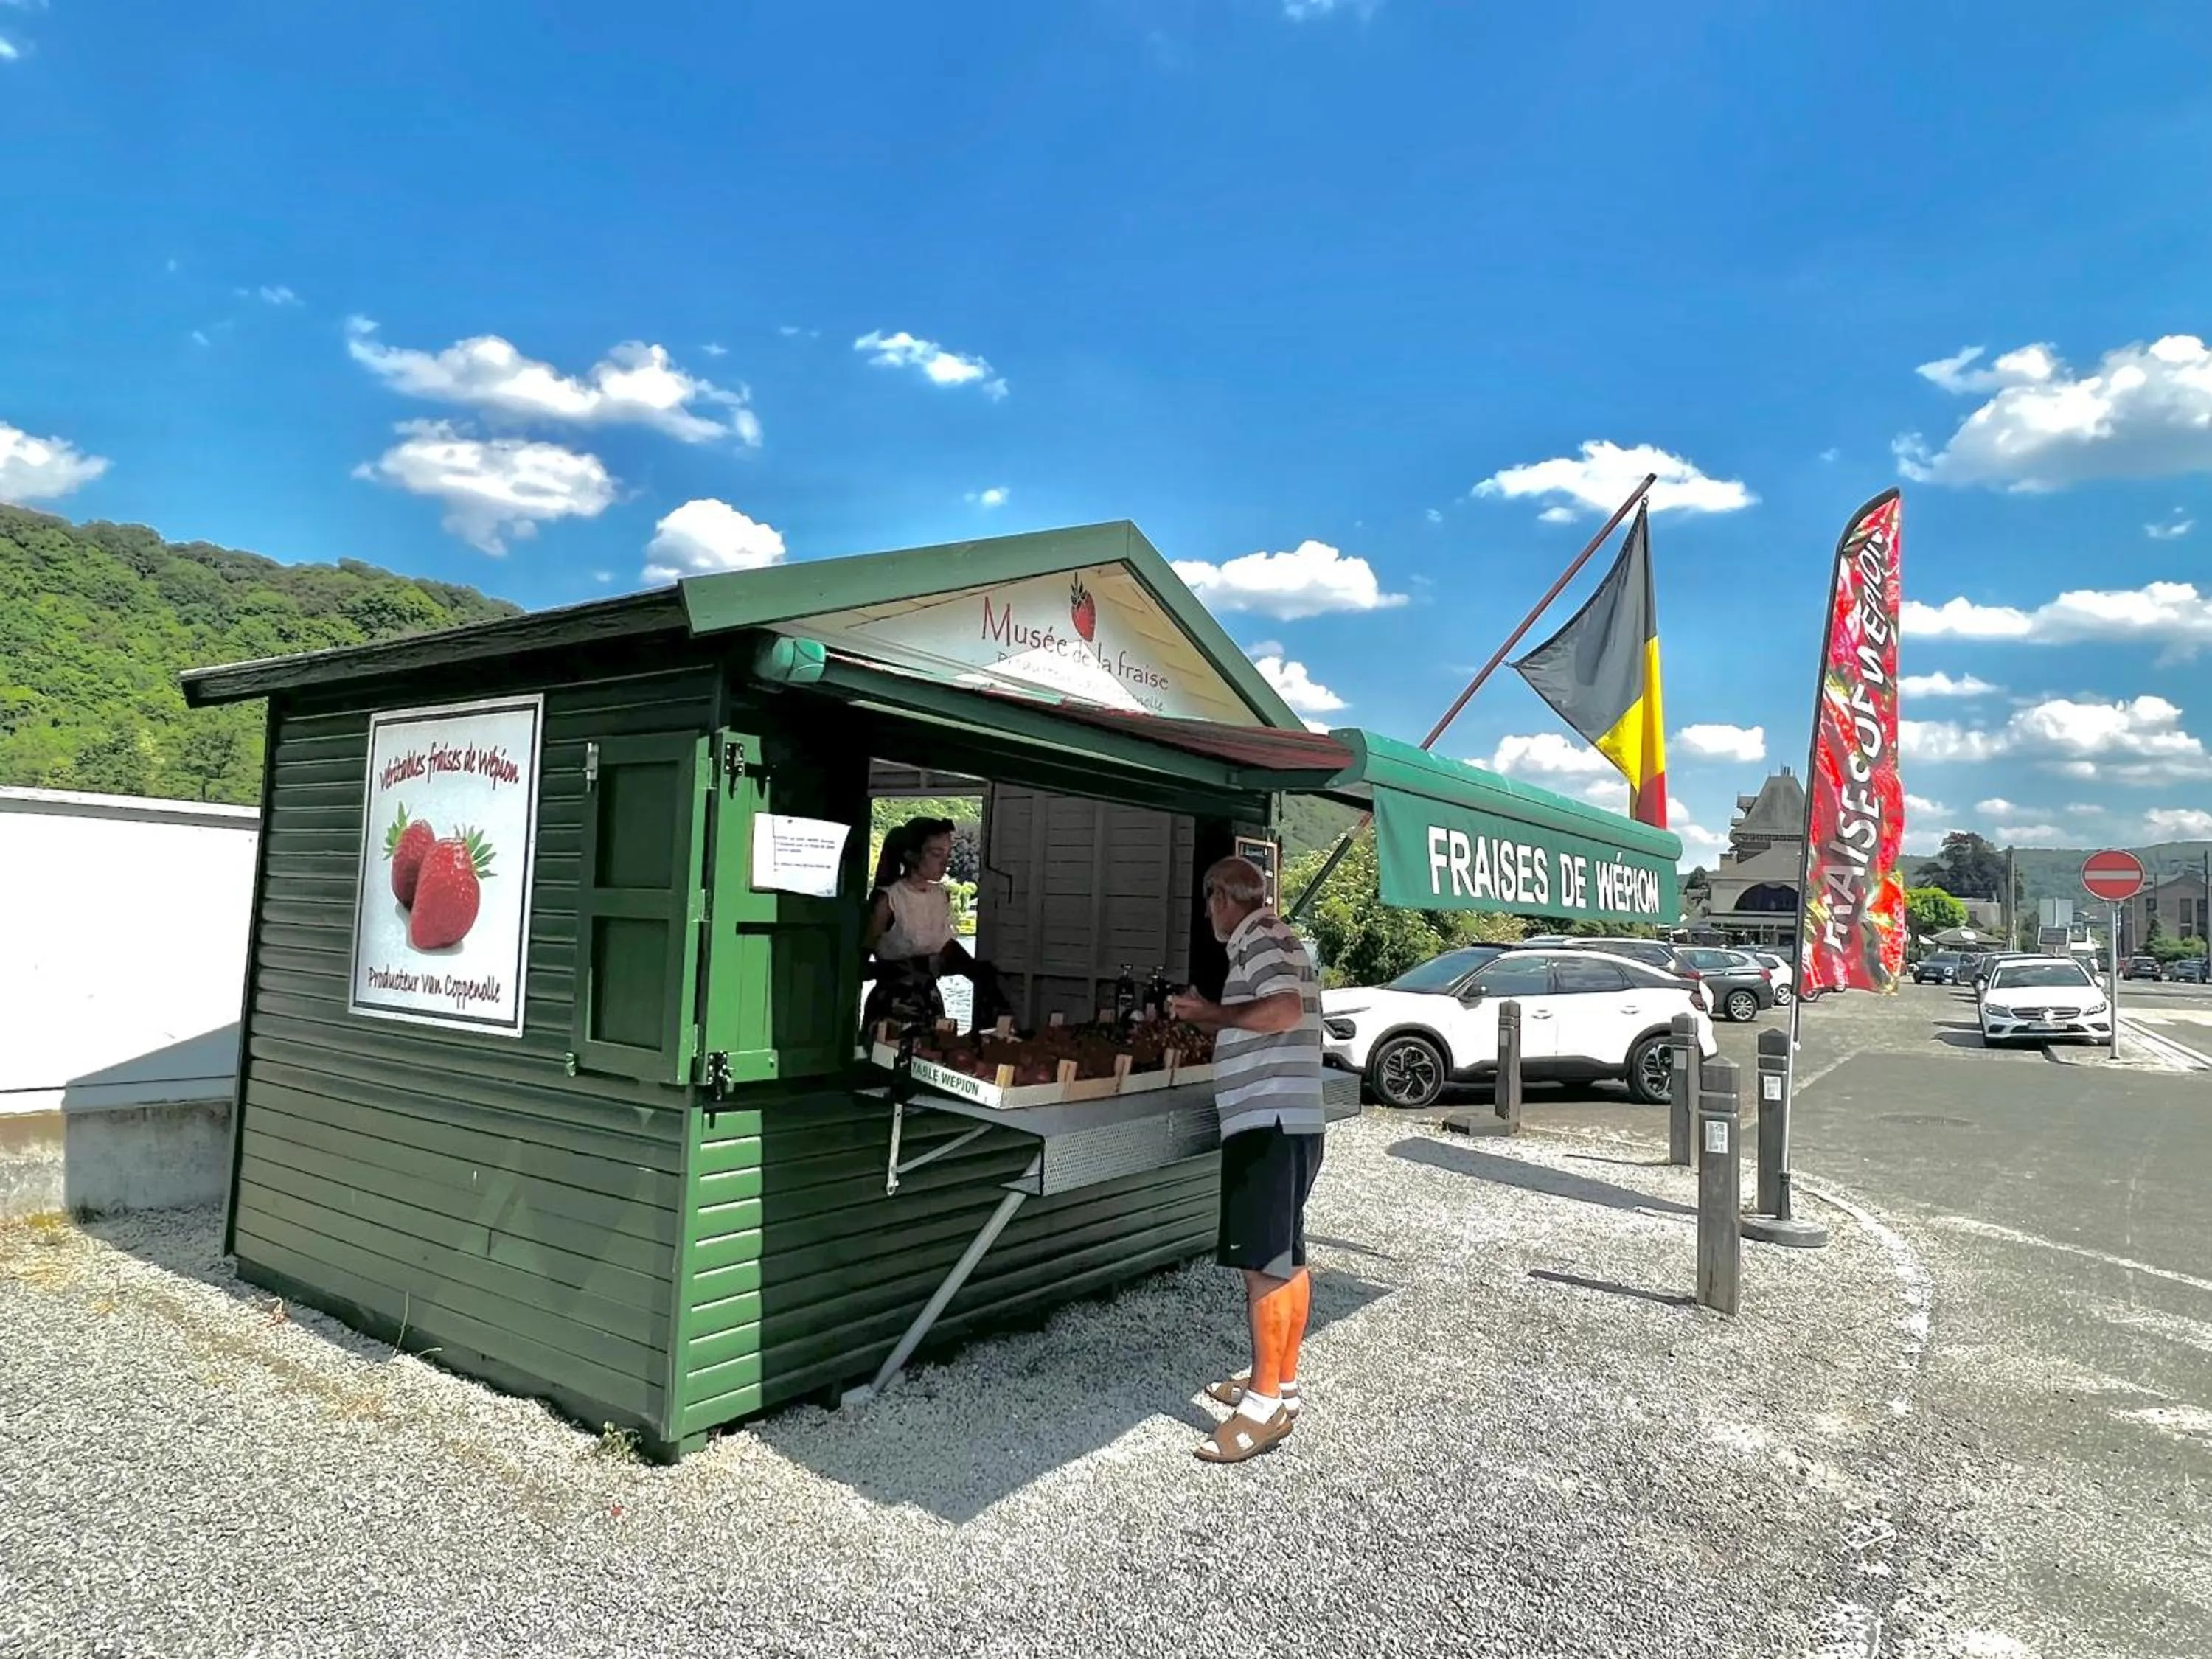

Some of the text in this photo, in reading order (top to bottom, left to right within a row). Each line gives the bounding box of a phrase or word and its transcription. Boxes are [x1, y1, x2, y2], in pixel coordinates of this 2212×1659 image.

[981, 596, 1068, 657] Musée
[1072, 640, 1090, 667] de
[1098, 642, 1111, 674] la
[1119, 651, 1169, 691] fraise
[428, 741, 462, 784] fraises
[464, 739, 476, 773] de
[1427, 825, 1660, 914] FRAISES DE WÉPION
[369, 964, 419, 992] Producteur
[421, 973, 442, 994] Van
[941, 1071, 979, 1096] WEPION
